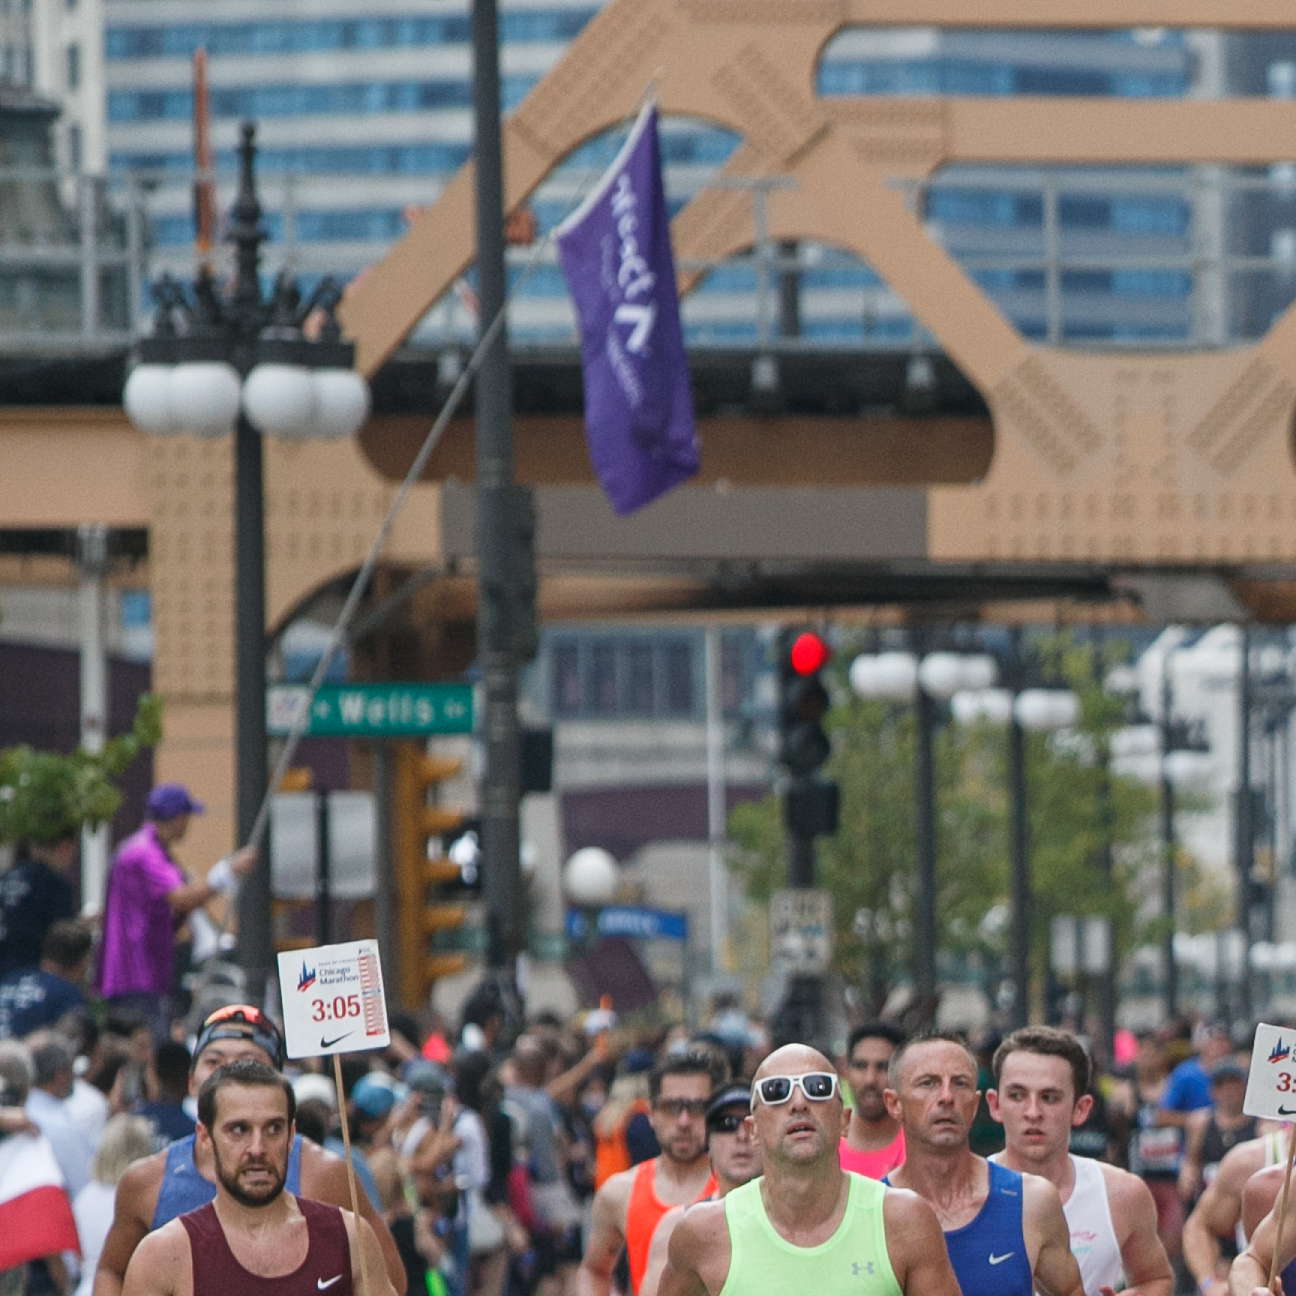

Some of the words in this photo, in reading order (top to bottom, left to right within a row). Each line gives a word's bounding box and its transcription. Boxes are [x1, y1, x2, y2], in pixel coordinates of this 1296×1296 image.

[338, 690, 435, 727] Wells
[319, 966, 351, 977] Chicago
[320, 974, 359, 986] Marathon
[311, 994, 361, 1022] 3:05
